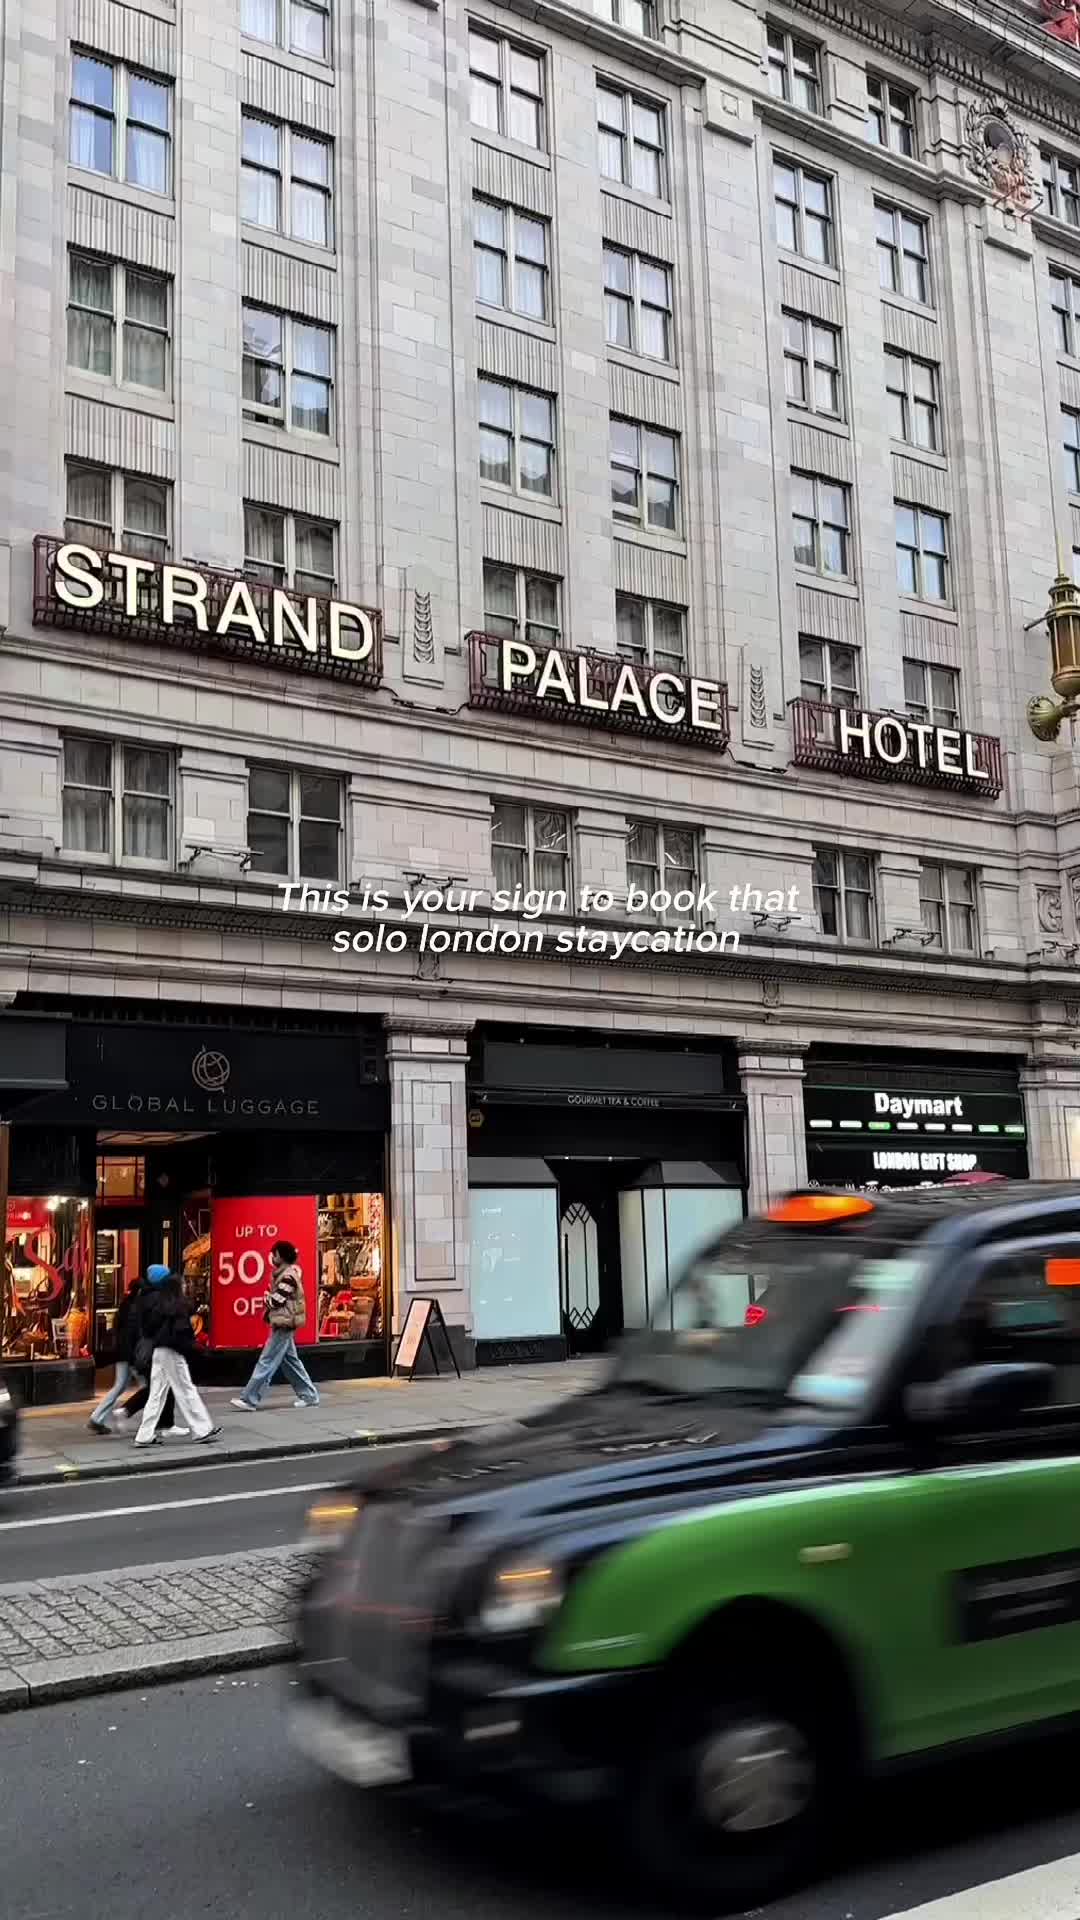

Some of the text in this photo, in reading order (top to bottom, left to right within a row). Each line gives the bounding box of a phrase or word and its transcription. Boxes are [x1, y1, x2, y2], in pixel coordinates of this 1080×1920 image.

[53, 543, 988, 779] STRAND PALACE HOTEL
[92, 1094, 320, 1115] GLOBAL LUGGAGE
[567, 1094, 606, 1105] GOURMET
[873, 1092, 963, 1119] Daymart
[872, 1151, 977, 1171] LONDON GIFT SHOP
[235, 1224, 278, 1238] UP TO
[233, 1296, 265, 1316] OF
